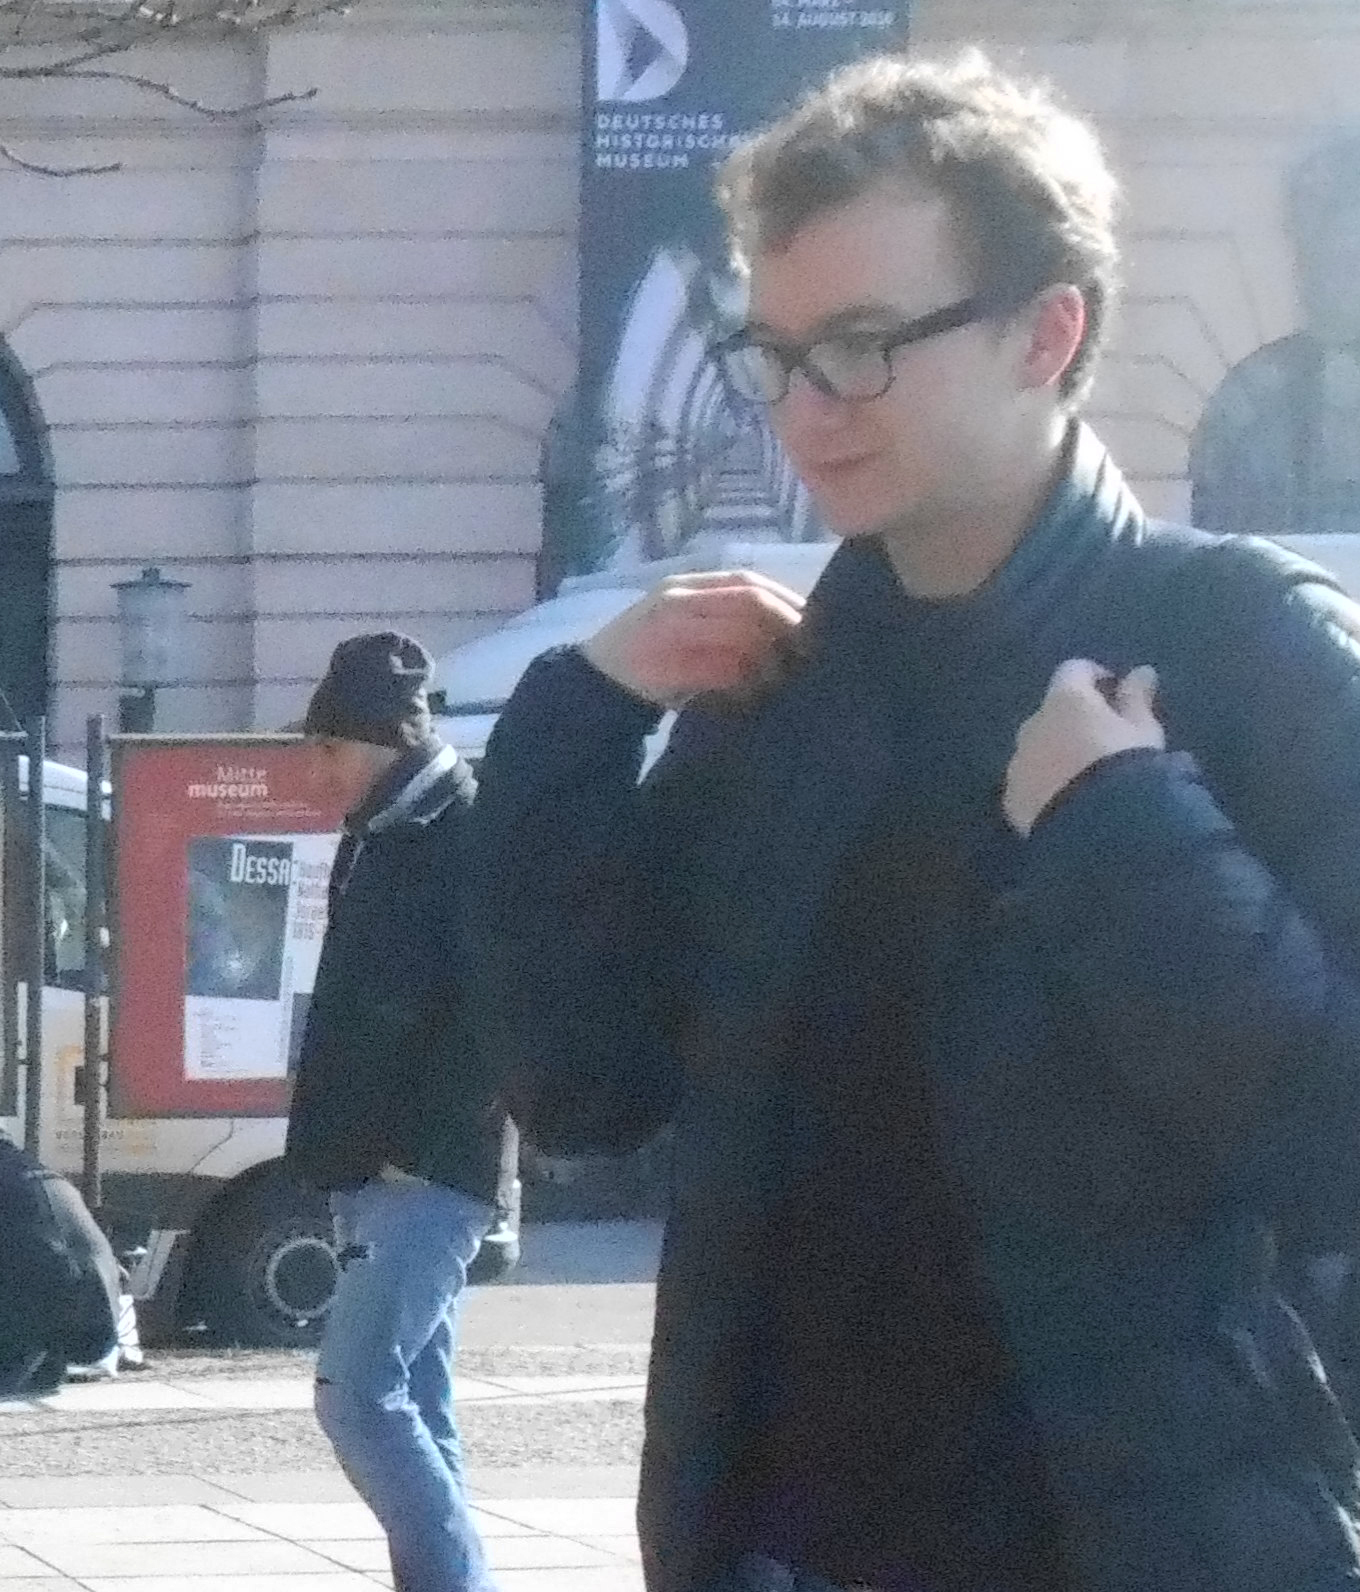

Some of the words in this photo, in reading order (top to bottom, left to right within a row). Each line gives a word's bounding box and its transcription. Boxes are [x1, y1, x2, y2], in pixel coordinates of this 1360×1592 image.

[596, 113, 724, 131] DEUTSCHES
[595, 152, 690, 169] MUSEUM
[188, 783, 269, 799] museum
[230, 842, 293, 886] DESSA
